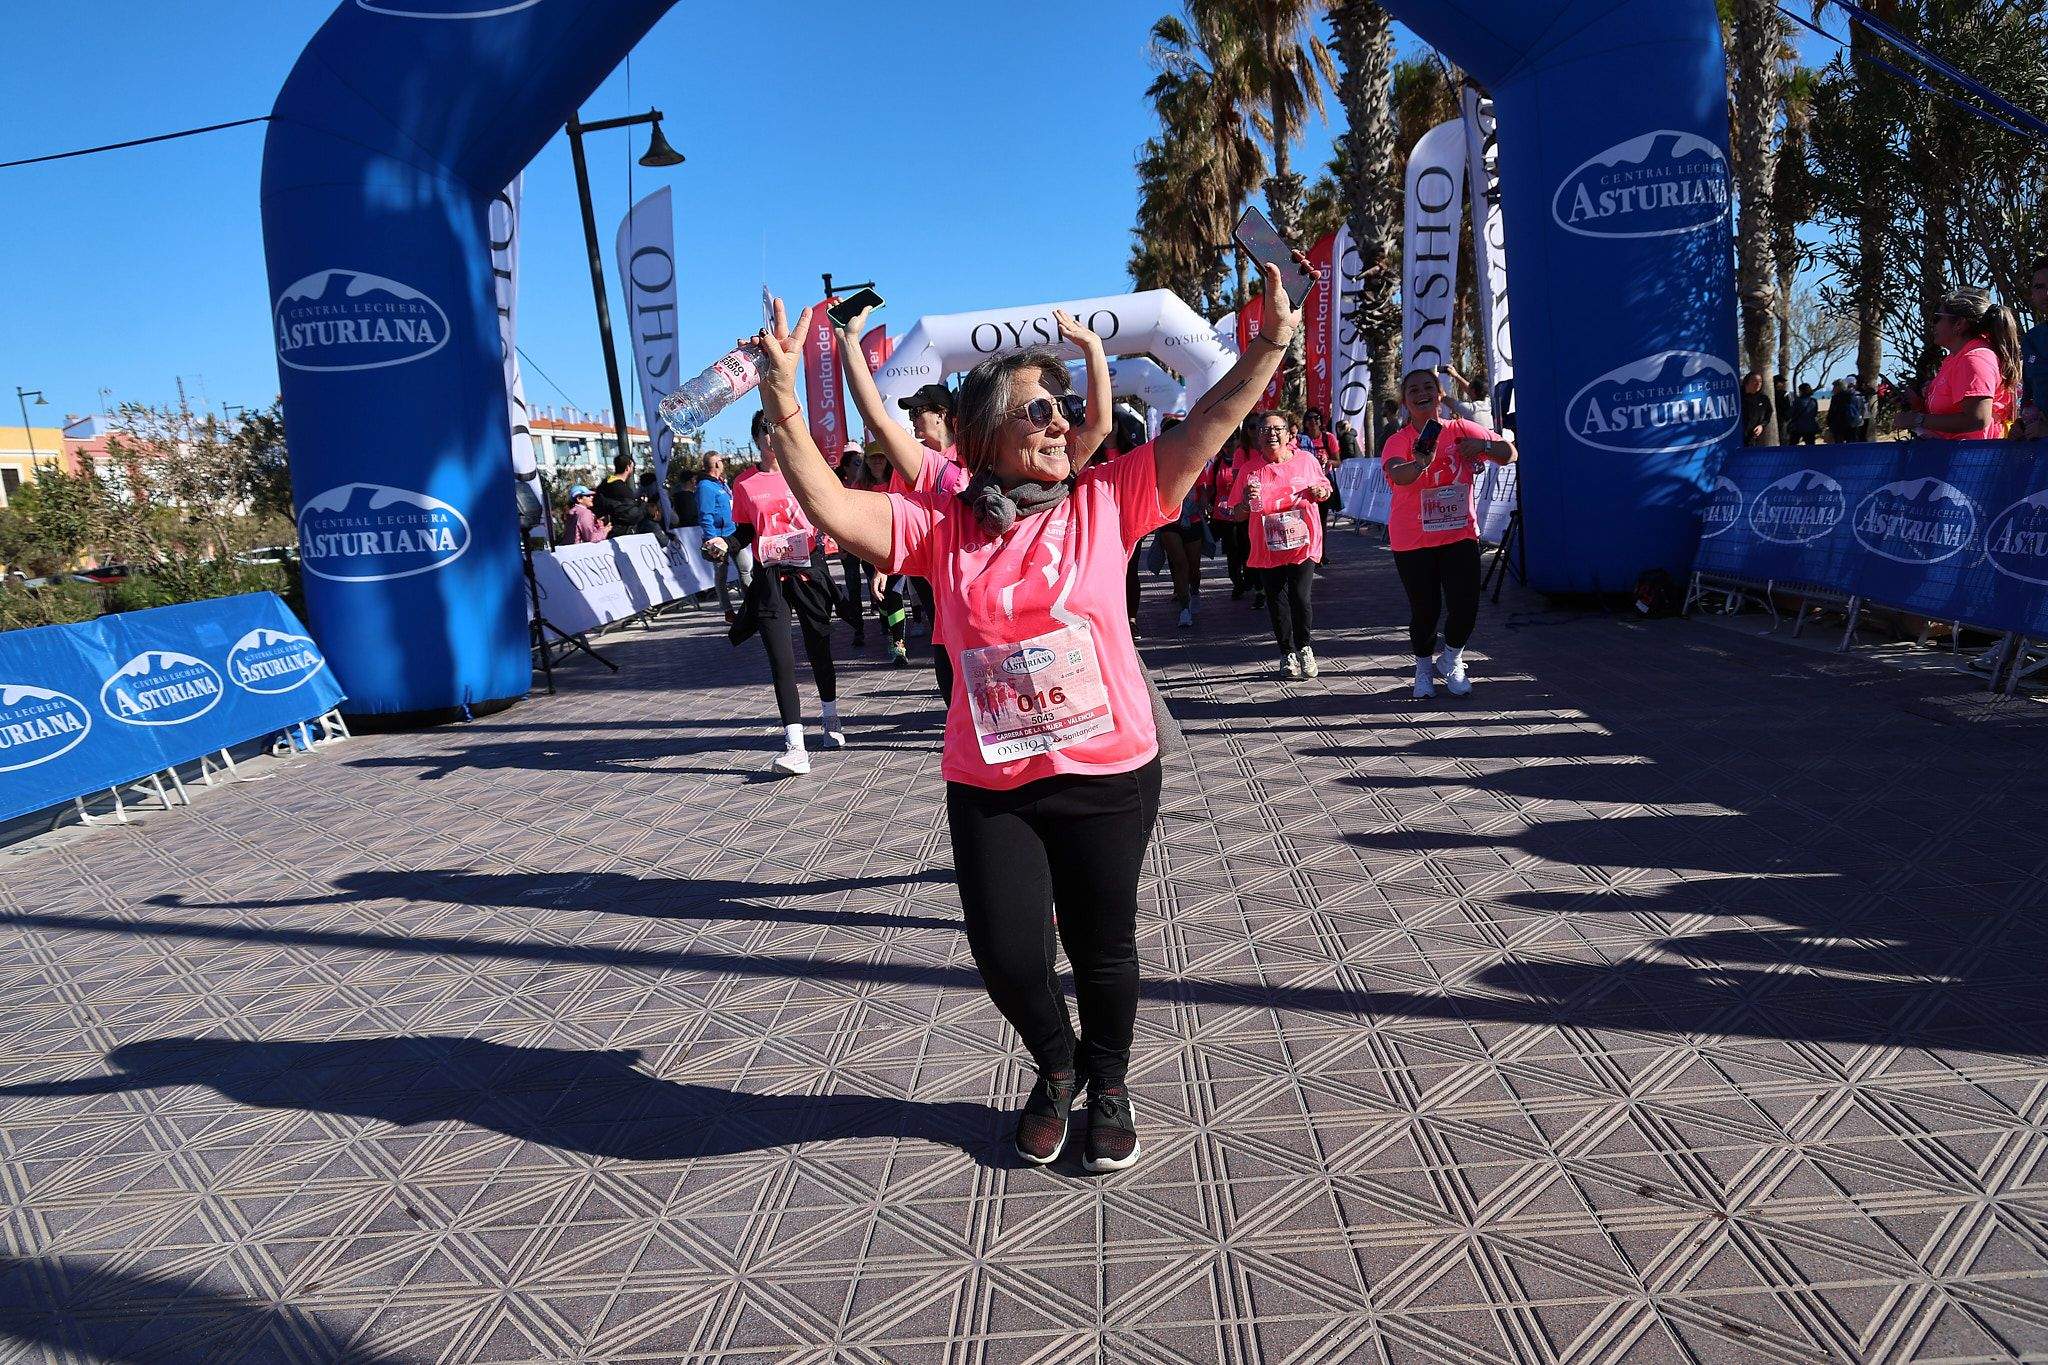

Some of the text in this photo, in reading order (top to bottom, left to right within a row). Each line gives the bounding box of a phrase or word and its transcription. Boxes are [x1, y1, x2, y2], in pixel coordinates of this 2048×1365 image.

[1600, 165, 1672, 185] CENTRAL
[1568, 178, 1728, 223] ASTURIANA
[290, 302, 427, 319] CENTRAL LECHERA
[1316, 261, 1332, 354] Santander
[279, 315, 438, 351] ASTURIANA
[1164, 333, 1210, 347] OYSHO
[817, 324, 836, 409] Santander
[886, 364, 930, 378] OYSHO
[1613, 385, 1683, 402] CENTRAL
[1581, 393, 1739, 435] ASTURIANA
[1754, 496, 1838, 525] ASTURIANA
[314, 513, 449, 529] CENTRAL LECHERA
[1857, 501, 1963, 547] ASTURIANA
[304, 523, 458, 559] ASTURIANA
[236, 649, 322, 684] ASTURIANA
[1006, 654, 1053, 672] ASTURIANA
[115, 676, 219, 718] ASTURIANA
[1017, 686, 1066, 713] 016
[14, 700, 68, 718] LECHERA
[1031, 712, 1055, 725] 5043
[996, 730, 1024, 741] CARRERA
[1033, 727, 1041, 735] LA
[1063, 723, 1100, 741] Santander
[997, 739, 1038, 756] OYSHO
